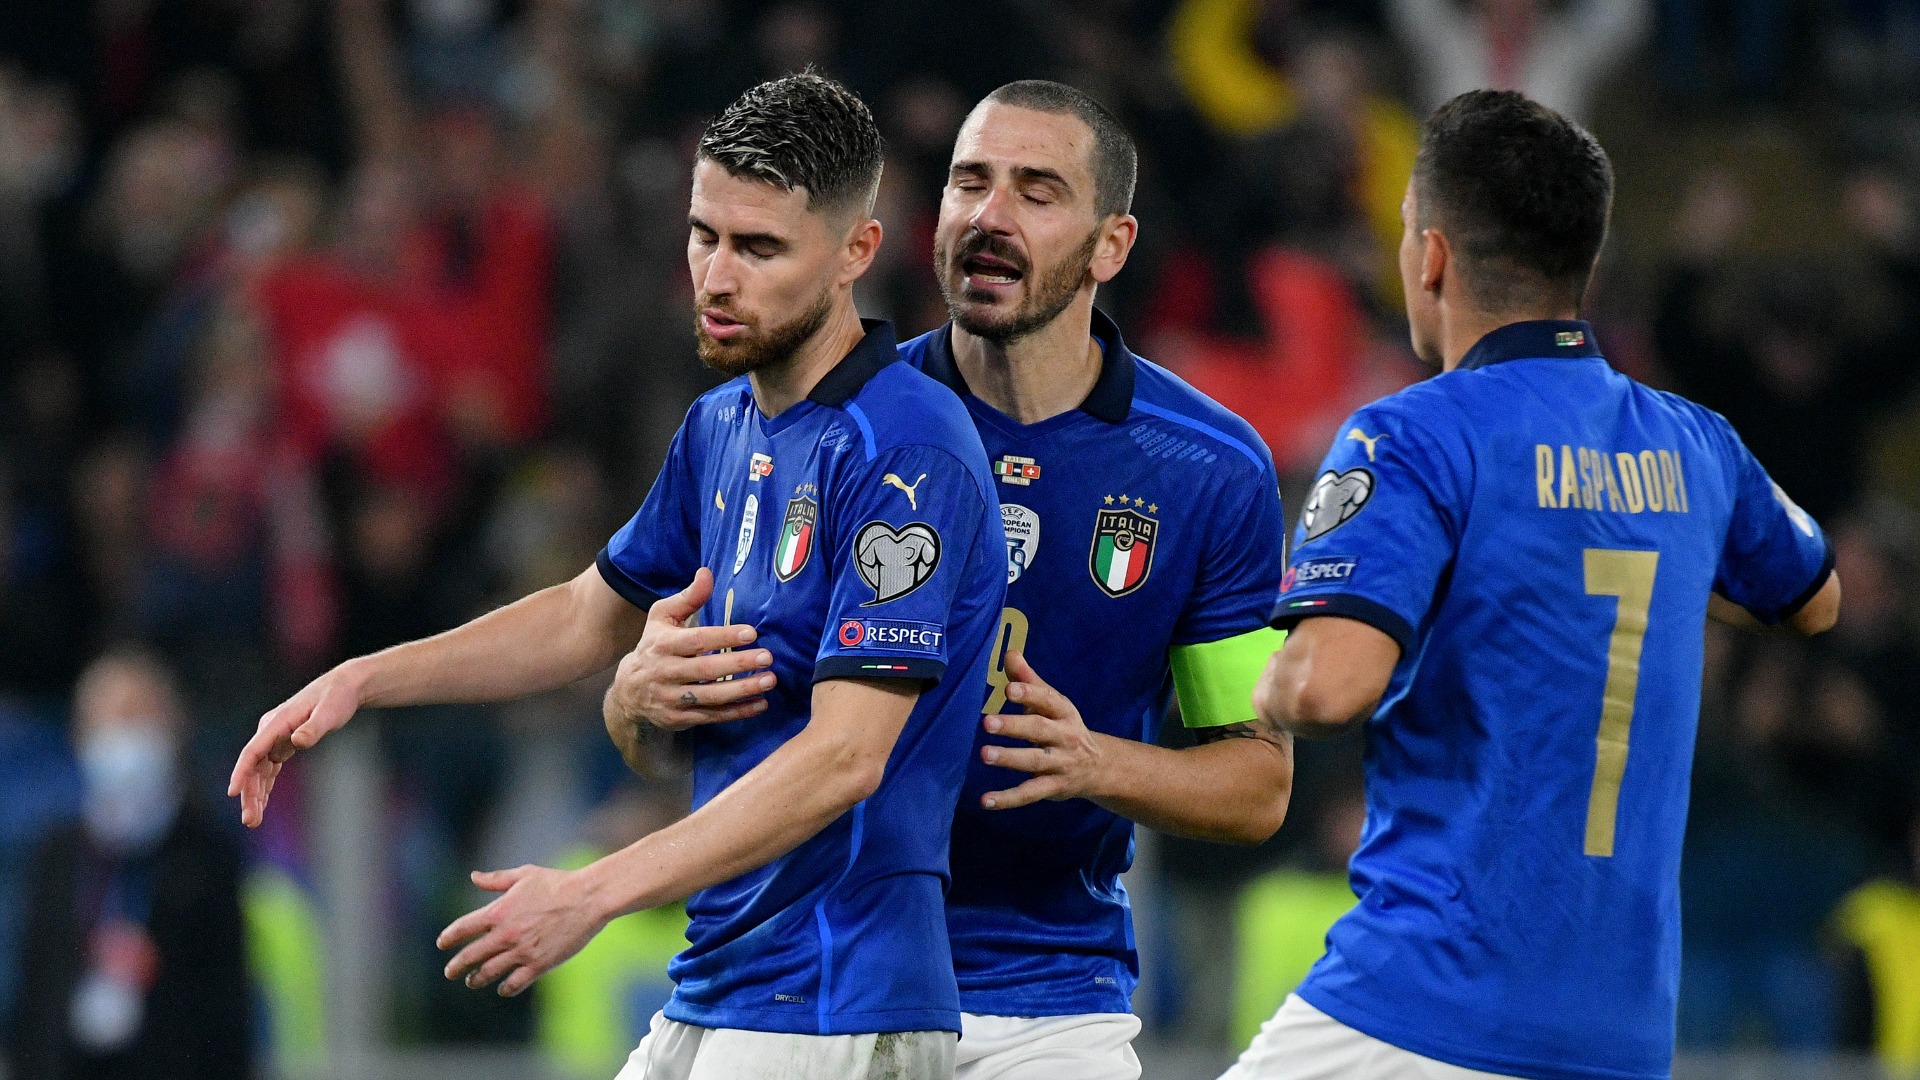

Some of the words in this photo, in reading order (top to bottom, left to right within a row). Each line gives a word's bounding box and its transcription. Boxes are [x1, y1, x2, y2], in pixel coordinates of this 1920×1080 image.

[1535, 444, 1689, 514] RASPADORI
[789, 503, 815, 519] ITALIA
[1001, 508, 1024, 518] UEFA
[1003, 519, 1032, 529] ROPEAN
[1004, 527, 1031, 535] MPIONS
[1102, 516, 1152, 537] ITALIA
[866, 626, 943, 647] RESPECT
[981, 607, 1029, 715] 9
[1583, 548, 1660, 857] 7
[775, 993, 806, 1004] DRYCELL
